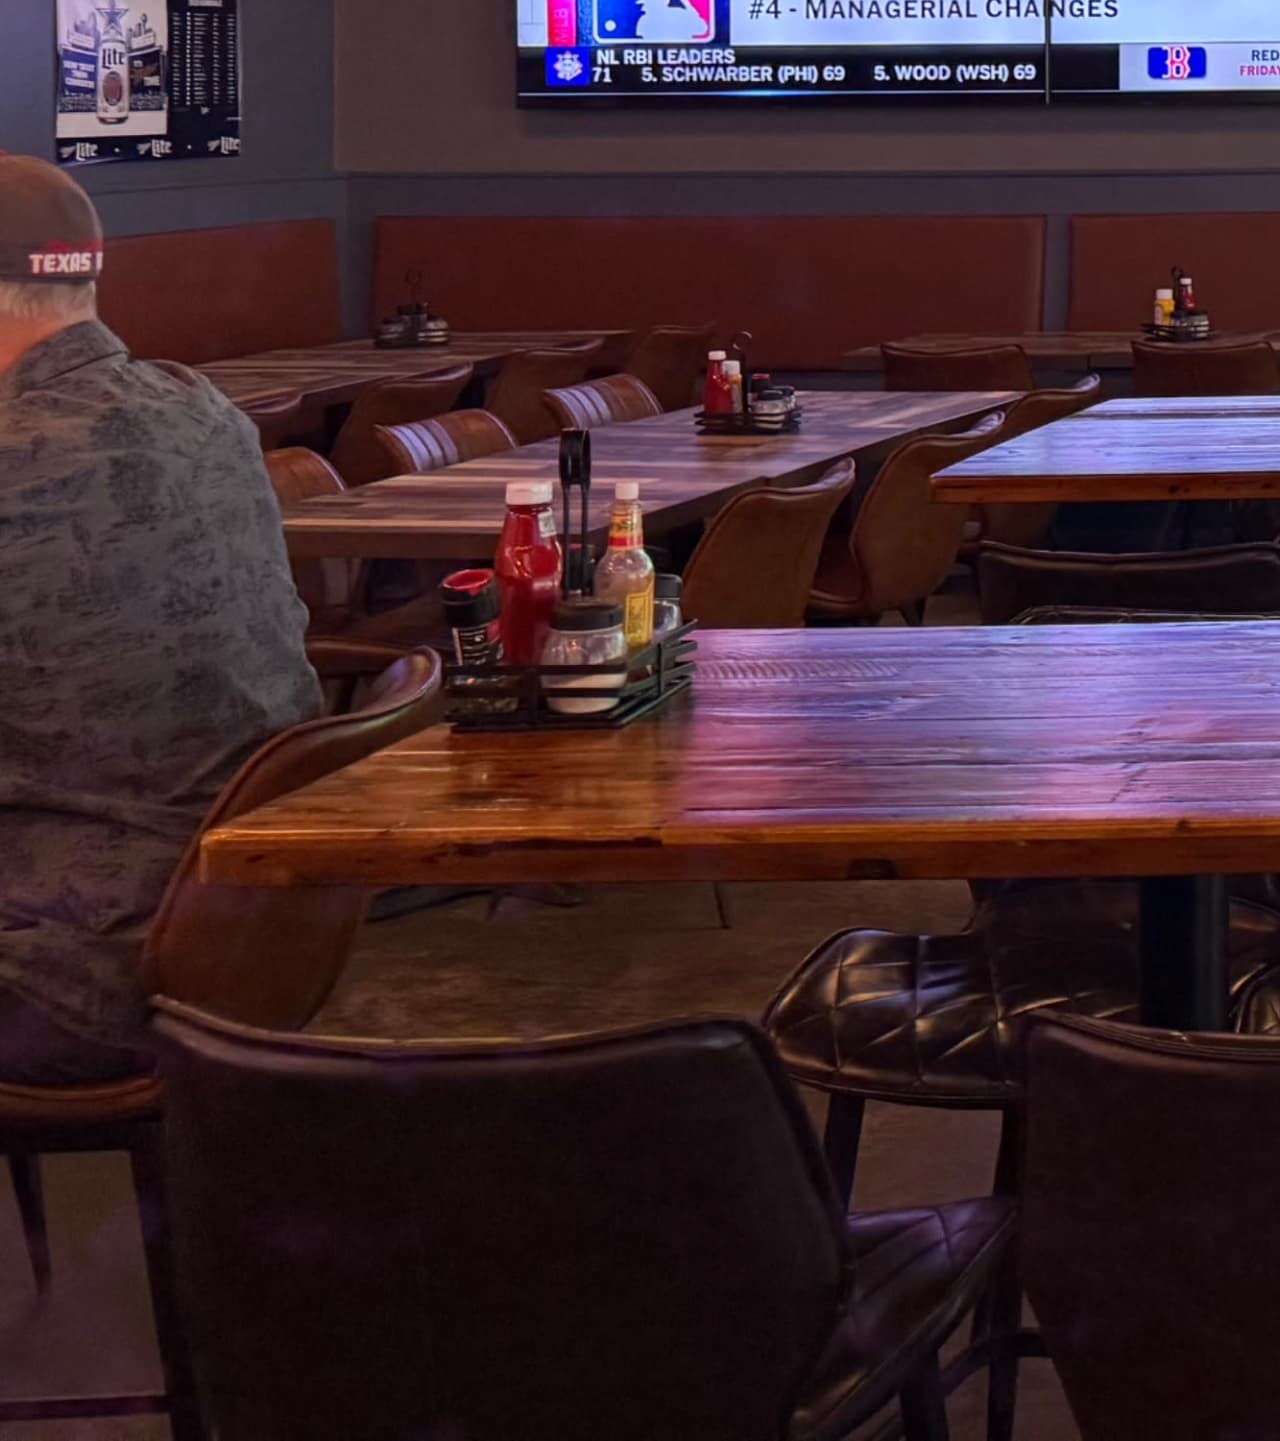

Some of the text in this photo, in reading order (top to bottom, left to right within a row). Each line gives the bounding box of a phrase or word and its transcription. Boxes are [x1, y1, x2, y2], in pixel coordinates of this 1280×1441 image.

[749, 0, 781, 19] #4
[596, 49, 736, 65] NL RBI LEADERS
[1251, 49, 1279, 61] RED
[592, 64, 1036, 83] 71 5. SCHWARBER (PHI) 69 5. WOOD (WSH) 69
[29, 252, 92, 273] TEXAS
